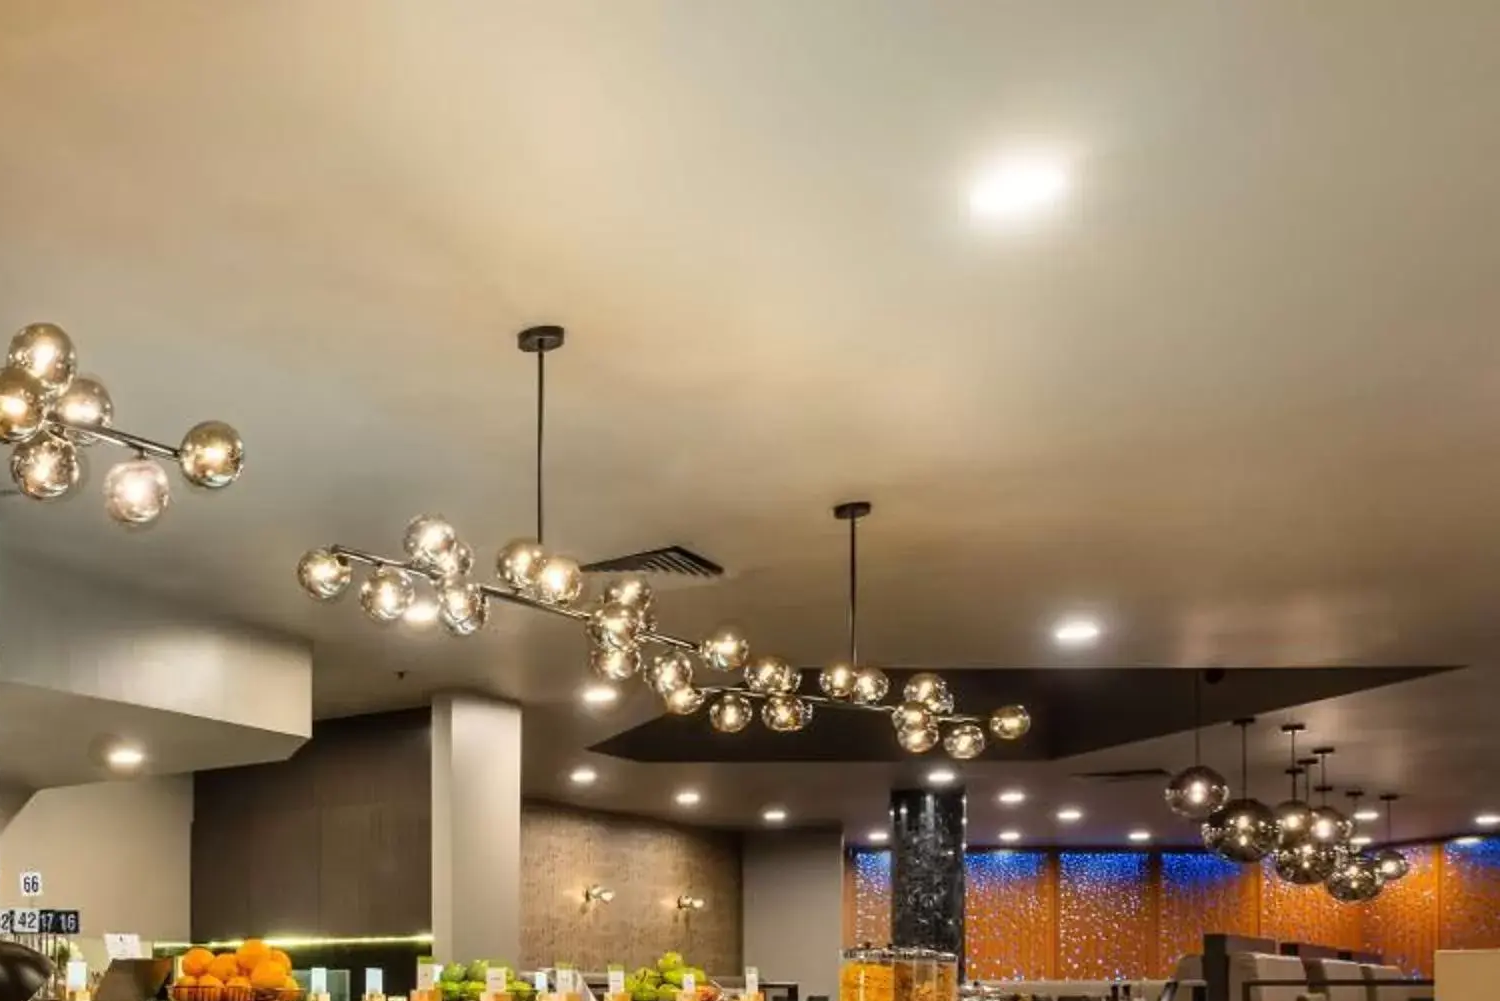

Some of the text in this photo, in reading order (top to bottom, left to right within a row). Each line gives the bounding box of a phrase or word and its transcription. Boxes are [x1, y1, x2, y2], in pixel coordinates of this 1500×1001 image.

[23, 875, 39, 893] 66
[18, 911, 37, 929] 42
[60, 913, 77, 931] 16
